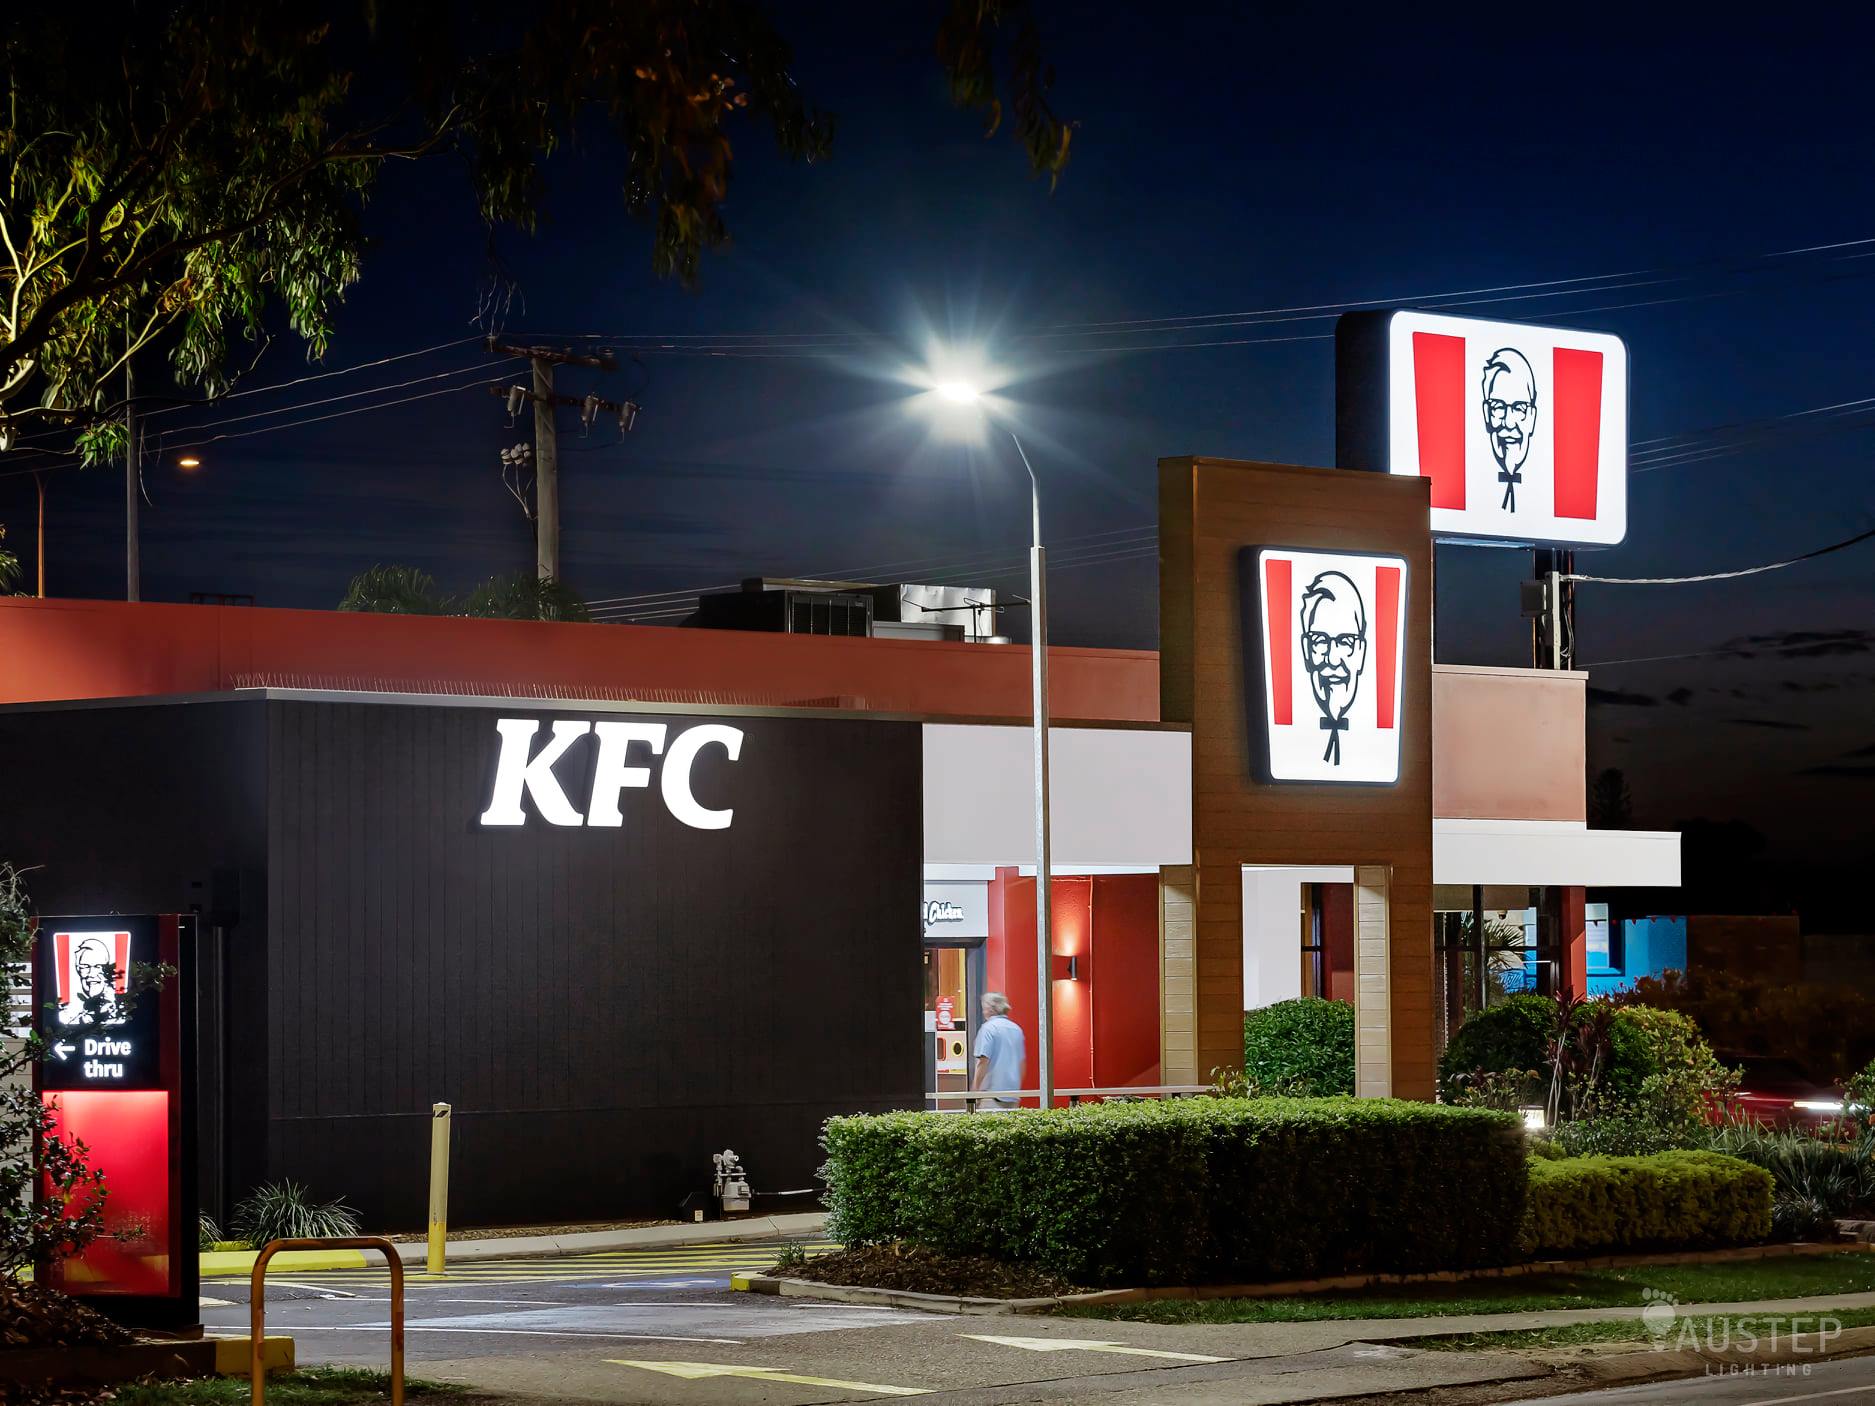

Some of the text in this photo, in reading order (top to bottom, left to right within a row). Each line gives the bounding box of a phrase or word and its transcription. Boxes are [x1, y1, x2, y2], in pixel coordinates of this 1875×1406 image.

[480, 718, 744, 830] KFC
[84, 1037, 132, 1056] Drive
[84, 1060, 123, 1078] thru
